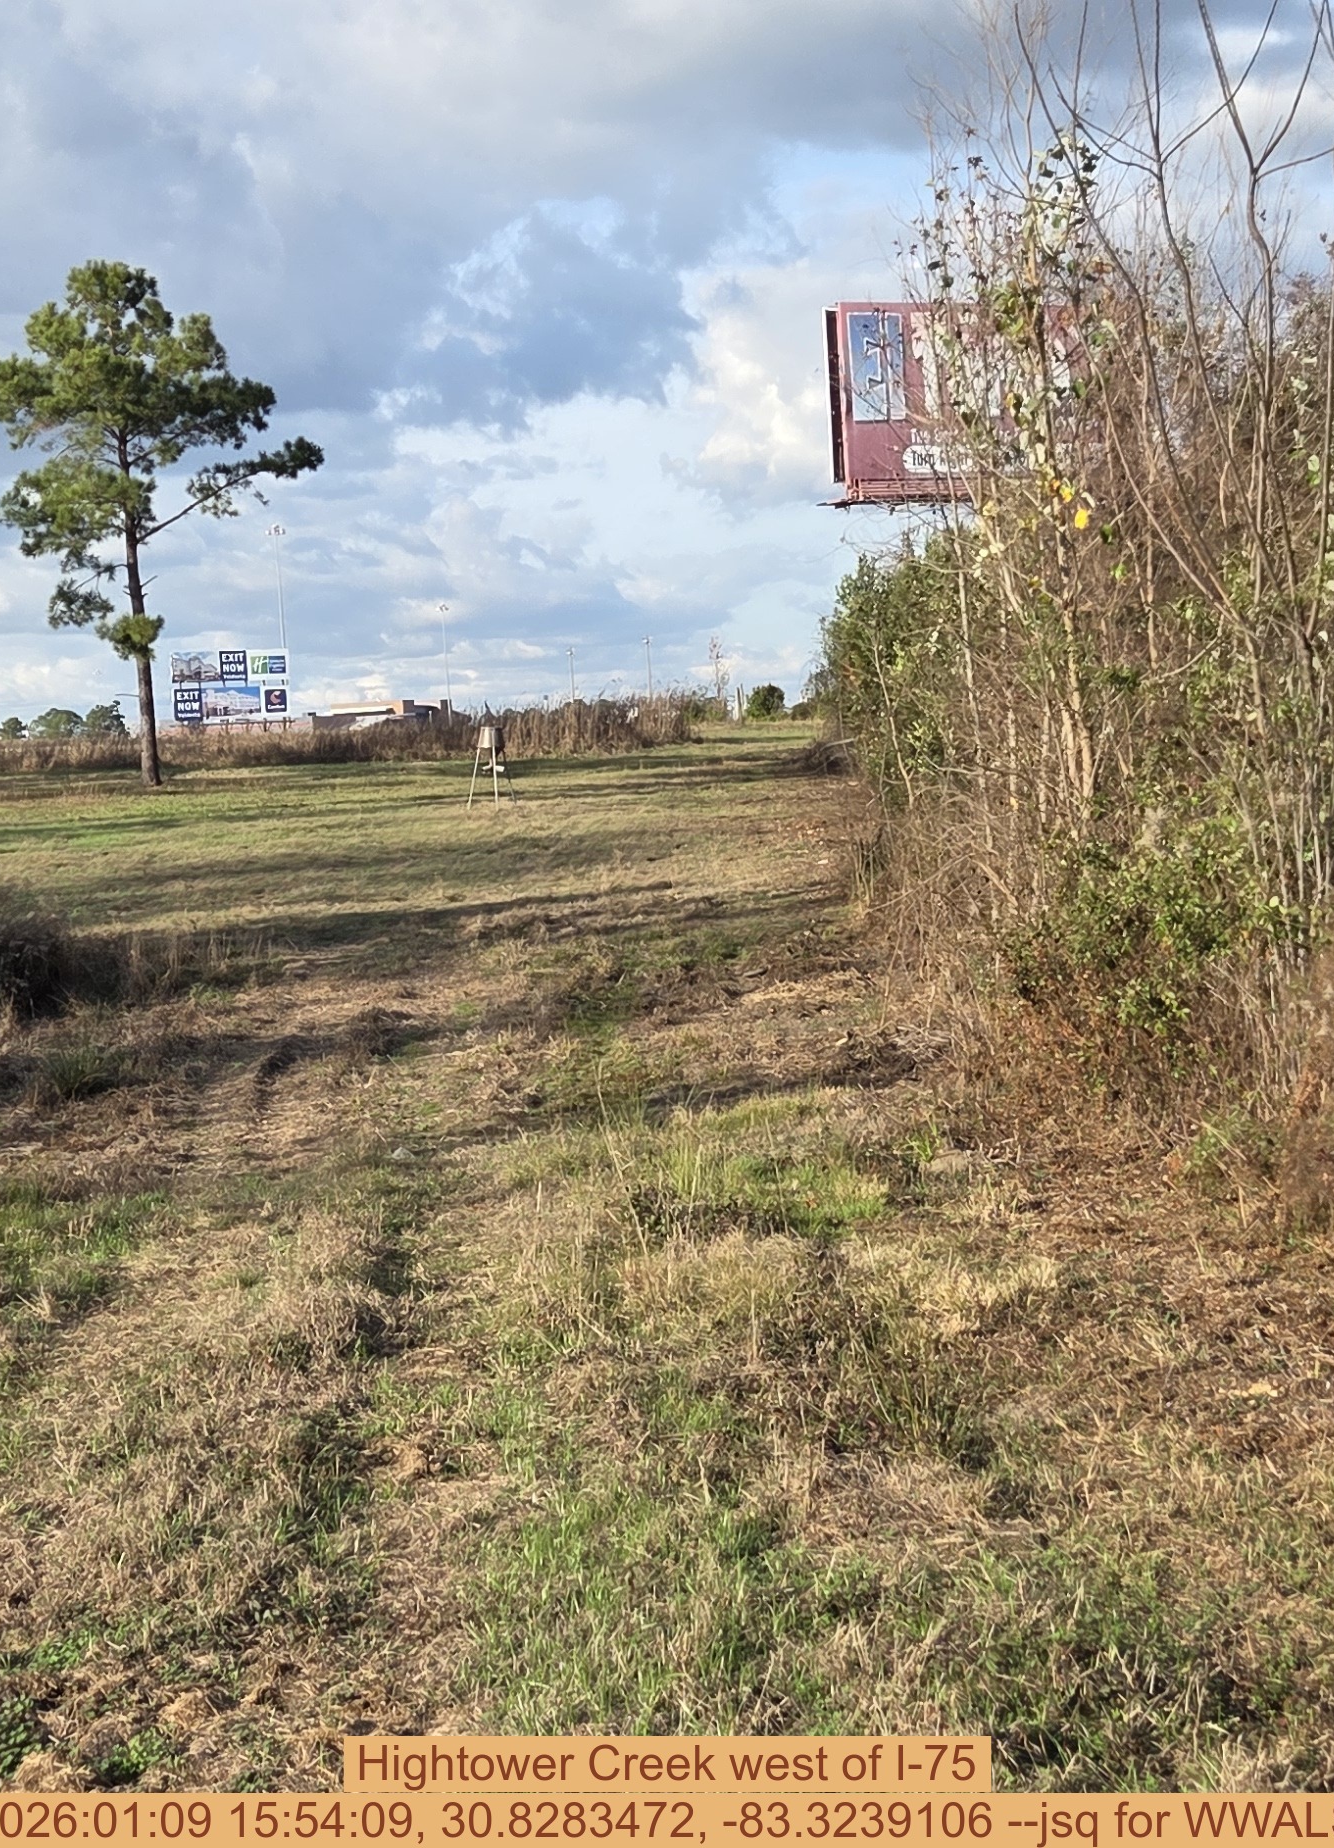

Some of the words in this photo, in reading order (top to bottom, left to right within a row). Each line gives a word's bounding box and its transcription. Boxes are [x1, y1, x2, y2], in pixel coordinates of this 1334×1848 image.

[222, 653, 244, 662] EXIT
[222, 663, 244, 672] NOW
[176, 691, 199, 701] EXIT
[177, 701, 200, 711] NOW
